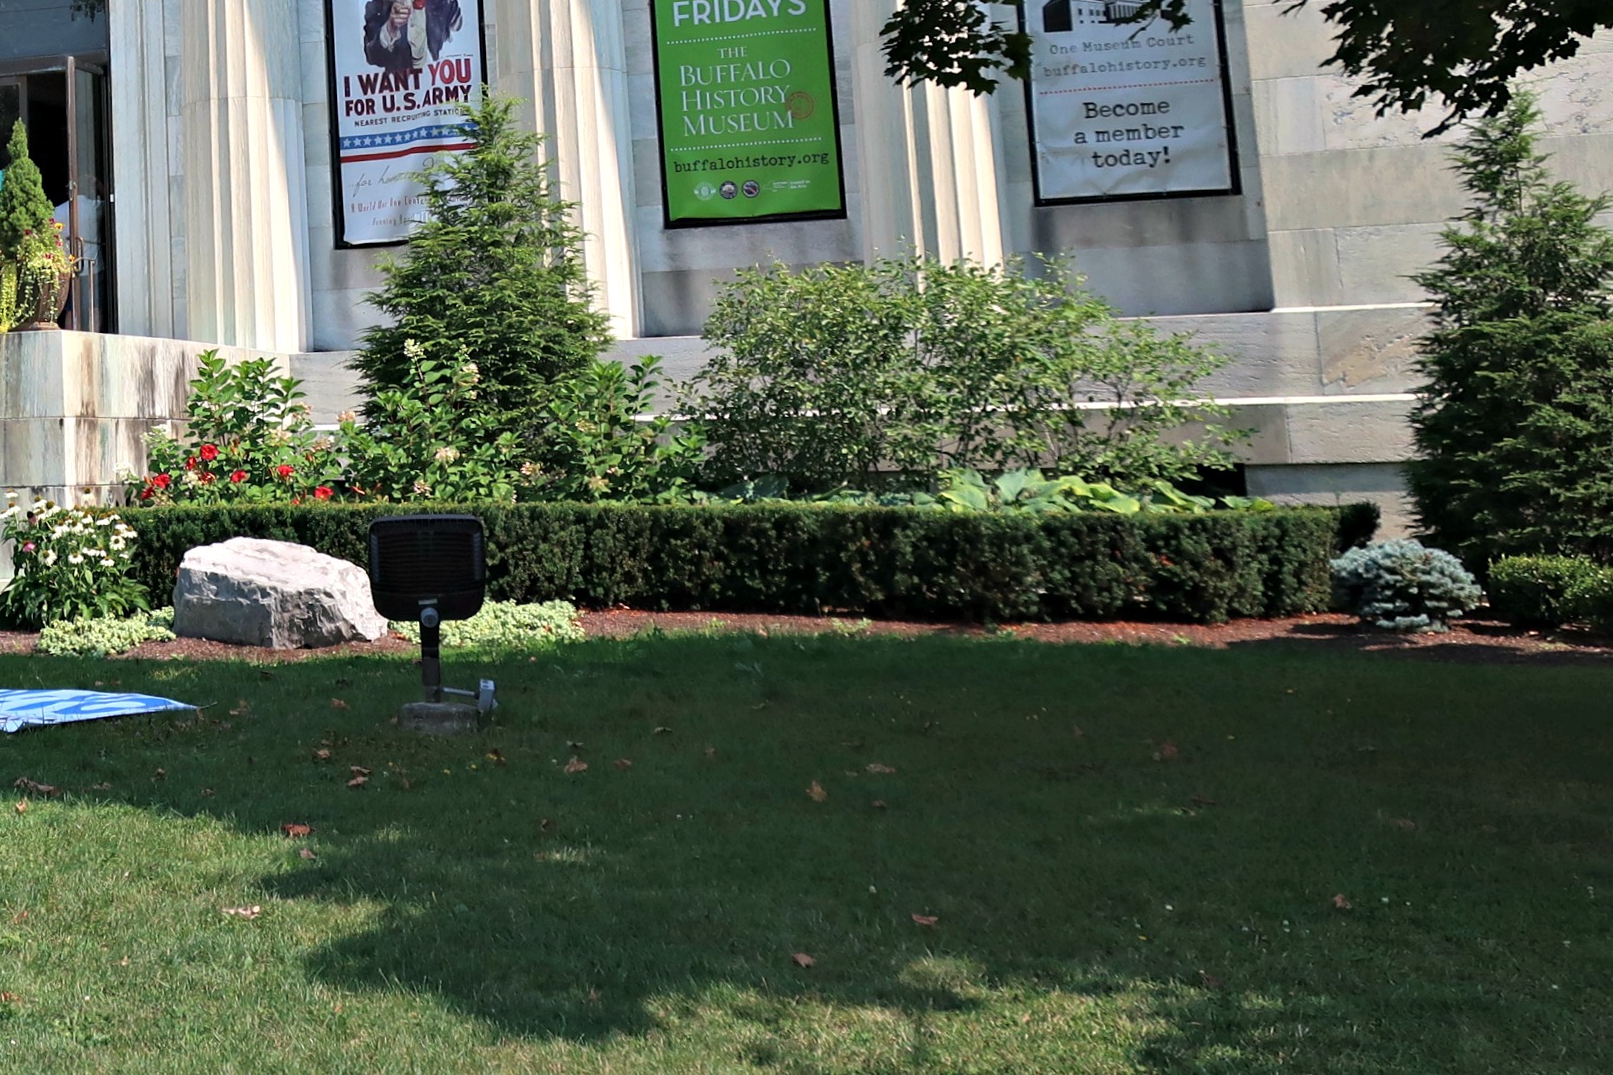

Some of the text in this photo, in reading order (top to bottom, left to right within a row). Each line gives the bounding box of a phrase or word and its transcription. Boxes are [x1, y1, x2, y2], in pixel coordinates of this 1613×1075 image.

[717, 46, 748, 59] THE
[1049, 34, 1195, 55] One Museum Court
[343, 58, 472, 98] I WANT YOU
[679, 58, 791, 87] BUFFALO
[1042, 57, 1207, 77] buffalohistory.org
[344, 98, 376, 117] FOR
[422, 85, 472, 107] ARMY
[681, 85, 790, 112] HISTORY
[1082, 100, 1170, 119] Become
[354, 116, 388, 127] NEAREST
[391, 109, 431, 123] RECRUITING
[682, 110, 794, 137] MUSEUM
[1073, 123, 1185, 144] a member
[673, 152, 829, 174] buffalohistory.org
[1091, 145, 1171, 168] today!
